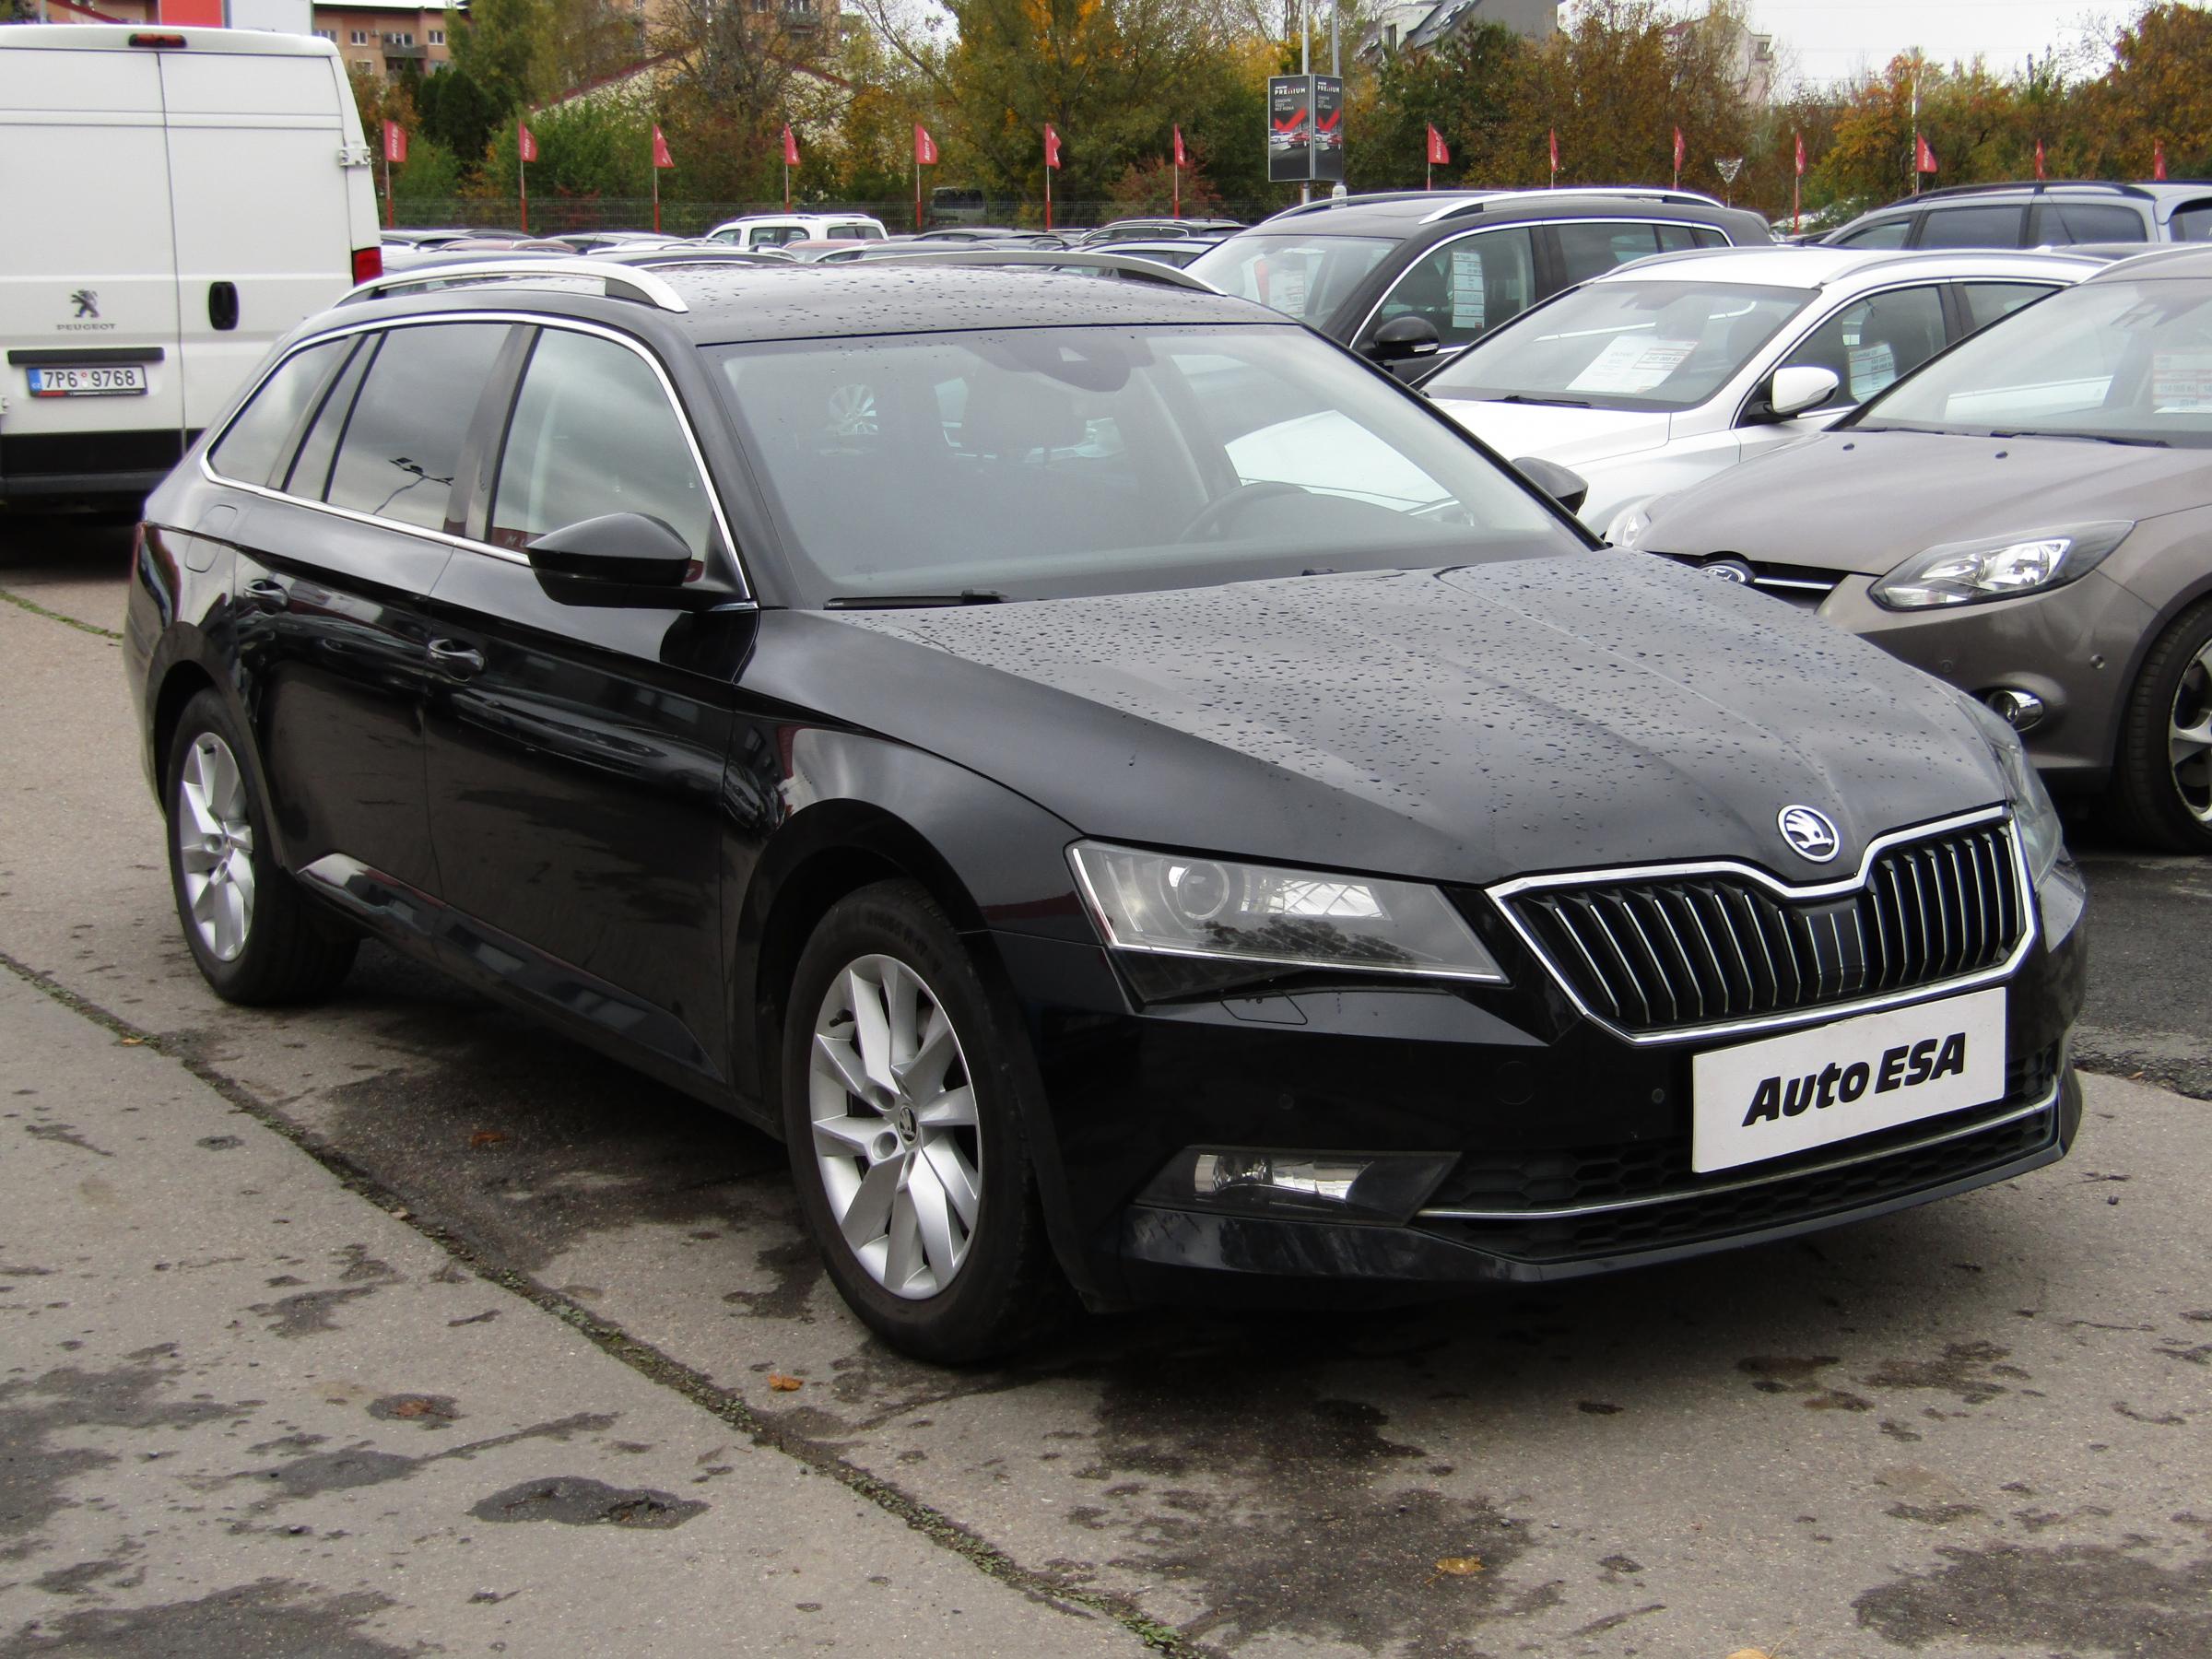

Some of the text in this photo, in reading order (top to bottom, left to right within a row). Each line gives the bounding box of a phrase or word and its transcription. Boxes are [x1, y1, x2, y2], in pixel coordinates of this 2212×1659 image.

[43, 370, 135, 389] 7P6 9768
[1741, 1031, 1966, 1127] Auto ESA
